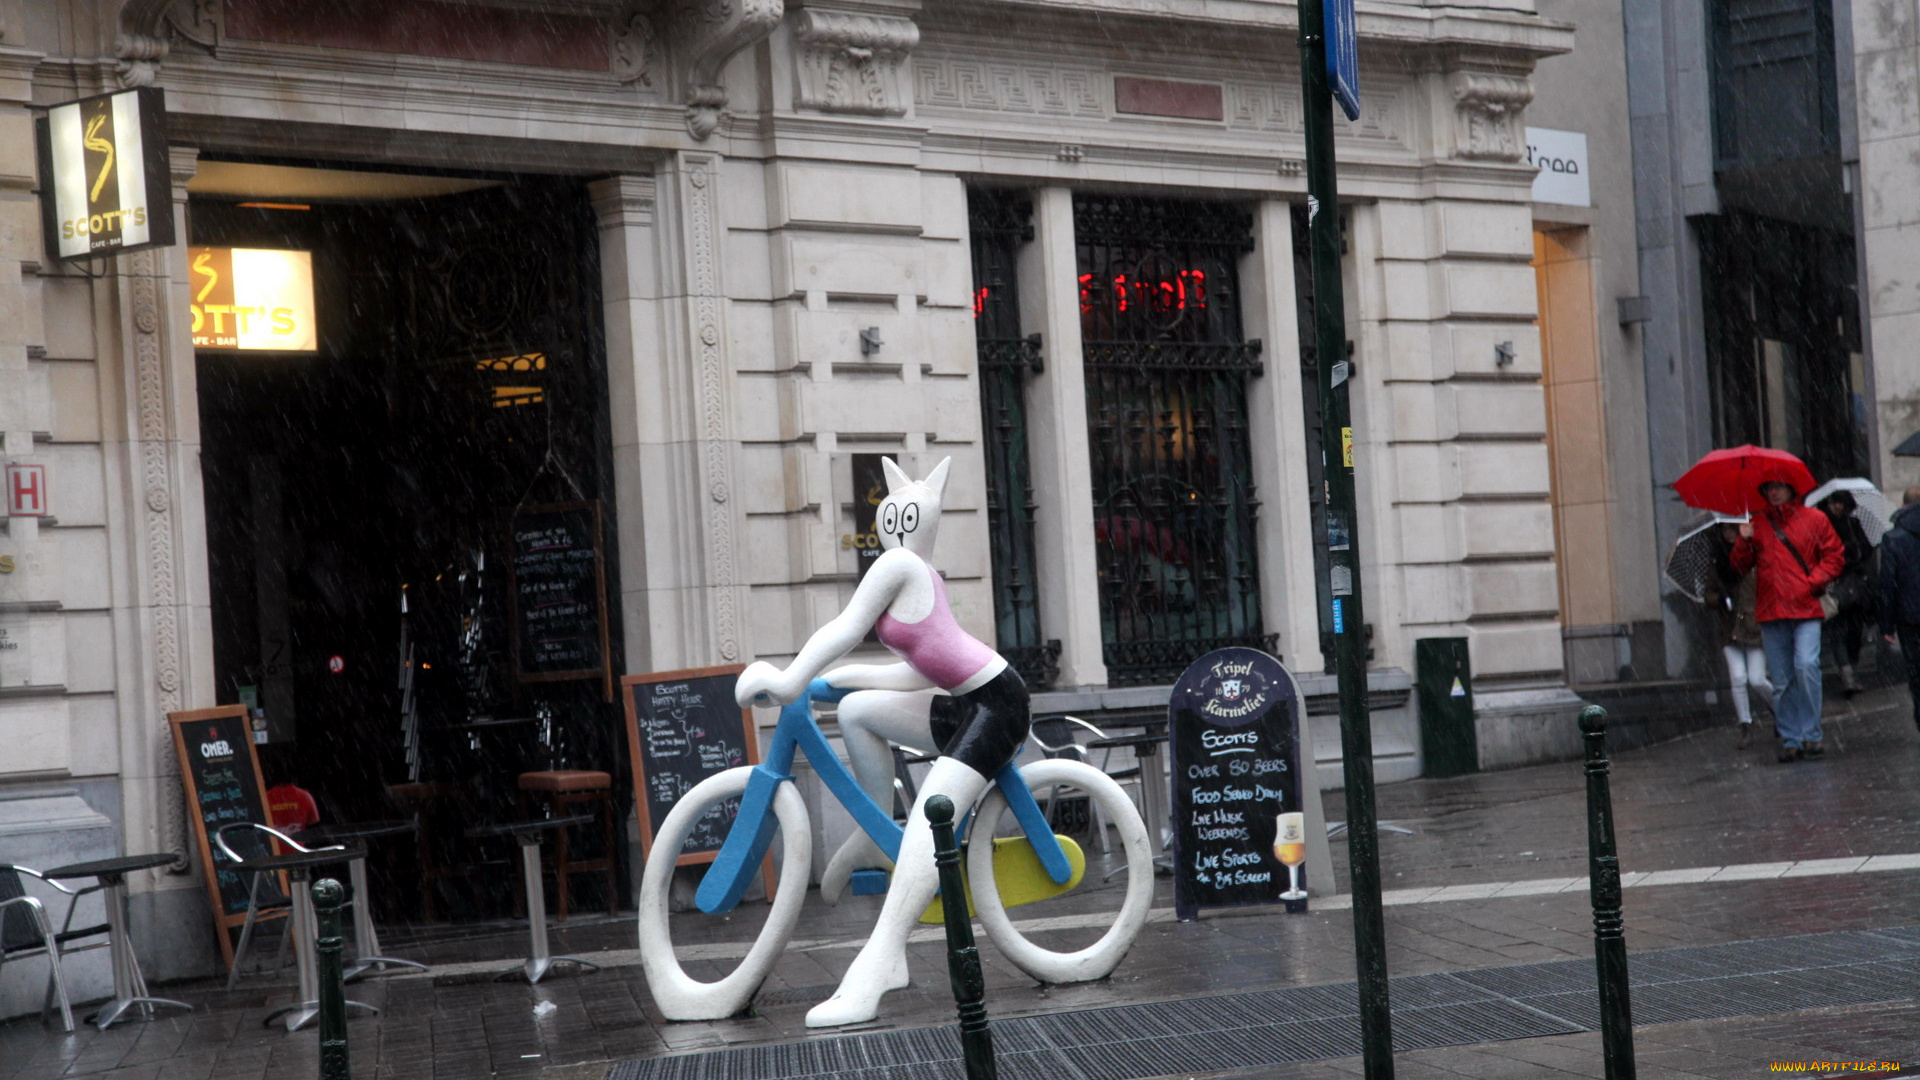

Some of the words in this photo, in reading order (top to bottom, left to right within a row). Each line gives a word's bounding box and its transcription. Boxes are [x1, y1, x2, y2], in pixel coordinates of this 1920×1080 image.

[62, 207, 146, 239] SCOTT'S
[91, 239, 106, 249] CAFE
[110, 237, 121, 245] BAR
[216, 337, 237, 346] BAR
[13, 471, 38, 510] H
[1211, 660, 1254, 679] Tripel
[1241, 685, 1251, 693] 79
[1203, 692, 1266, 718] Karmeliet
[201, 740, 234, 758] OMER.
[1188, 764, 1220, 779] OVER
[1229, 759, 1249, 776] 80
[1252, 758, 1287, 776] BEERS
[1192, 786, 1221, 804] FOOD
[1223, 785, 1253, 802] SERVED
[1192, 810, 1211, 826] LIVE
[1213, 808, 1245, 825] MUSIC
[1198, 827, 1251, 840] WEEKENDS
[1194, 851, 1219, 871] LIVE
[1222, 848, 1261, 868] SPORTS
[1215, 871, 1232, 890] BIG
[1235, 869, 1271, 885] SCREEN
